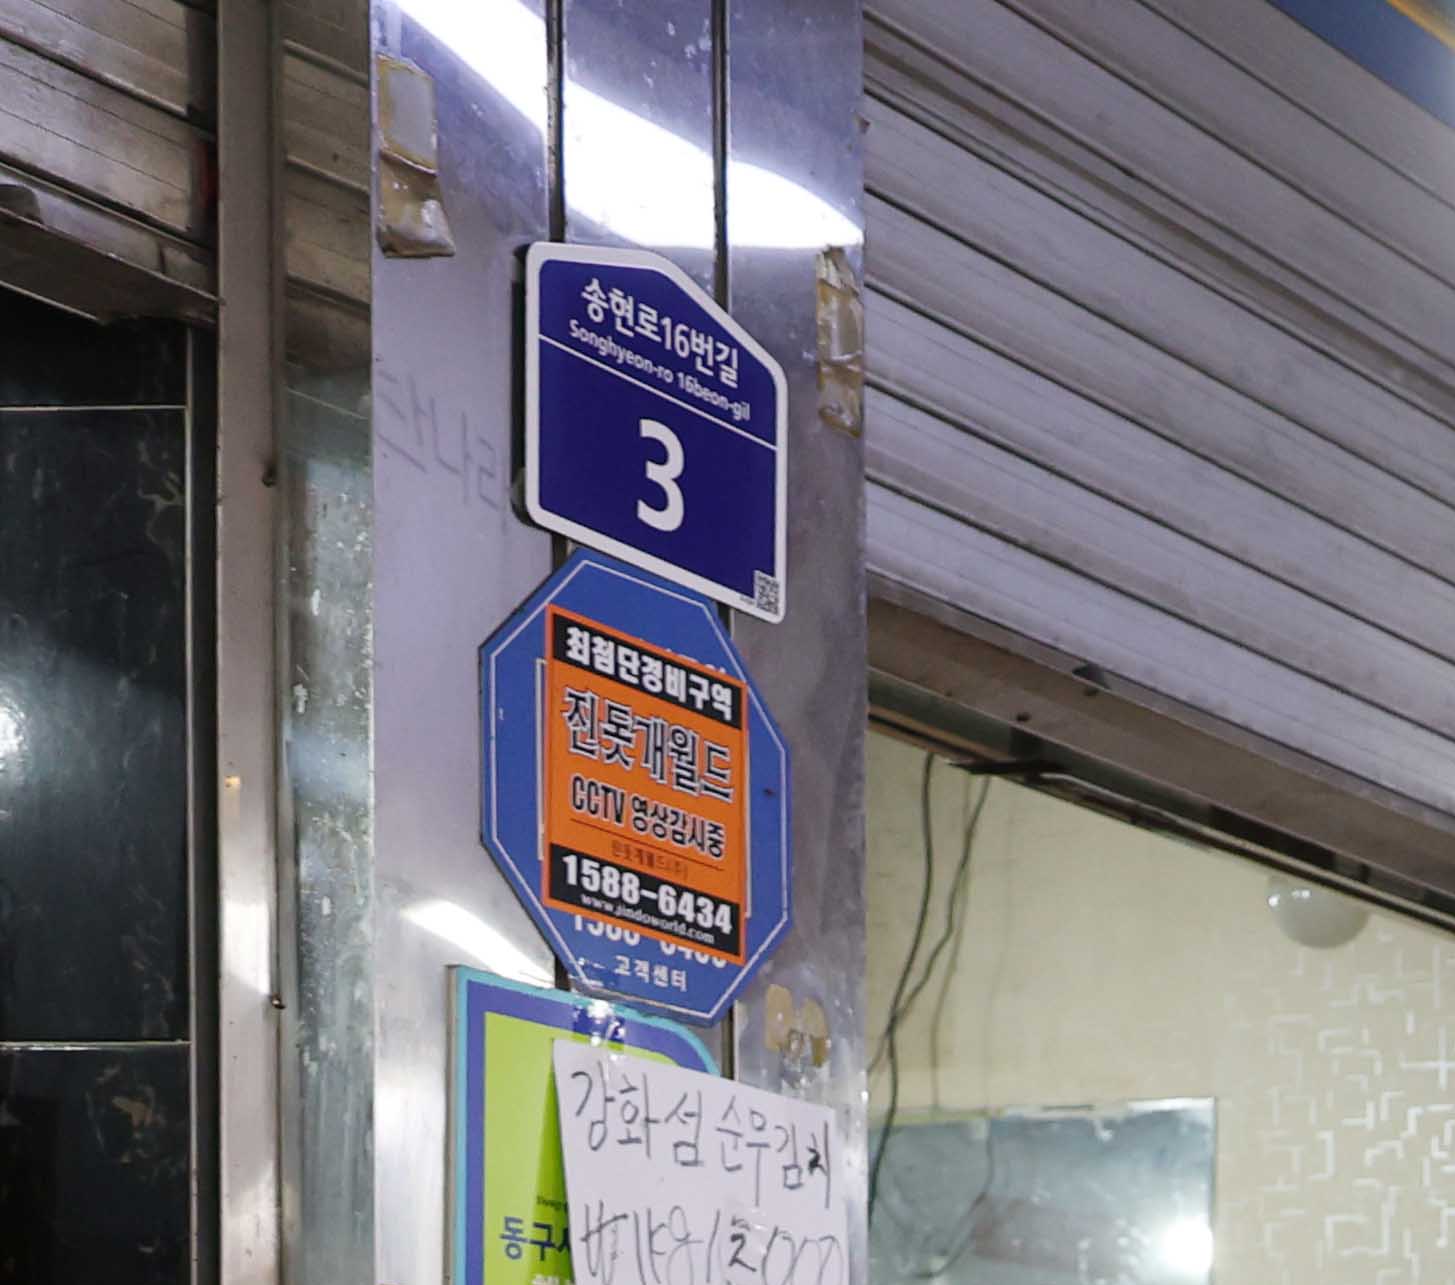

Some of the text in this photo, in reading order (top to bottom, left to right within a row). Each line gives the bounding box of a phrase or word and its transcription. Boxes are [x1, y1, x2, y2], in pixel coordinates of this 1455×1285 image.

[569, 319, 751, 422] Songhyeon-ro 16beon-gil
[582, 278, 740, 389] 송현로16번길
[636, 418, 685, 532] 3
[566, 624, 734, 721] 최첨단경비구역
[562, 686, 735, 804] 진돗개월드
[570, 774, 726, 861] CCTV 영상감시중
[563, 853, 734, 937] 1588-6434
[580, 890, 716, 946] www.jindoworld.com
[614, 954, 689, 993] 고객센터
